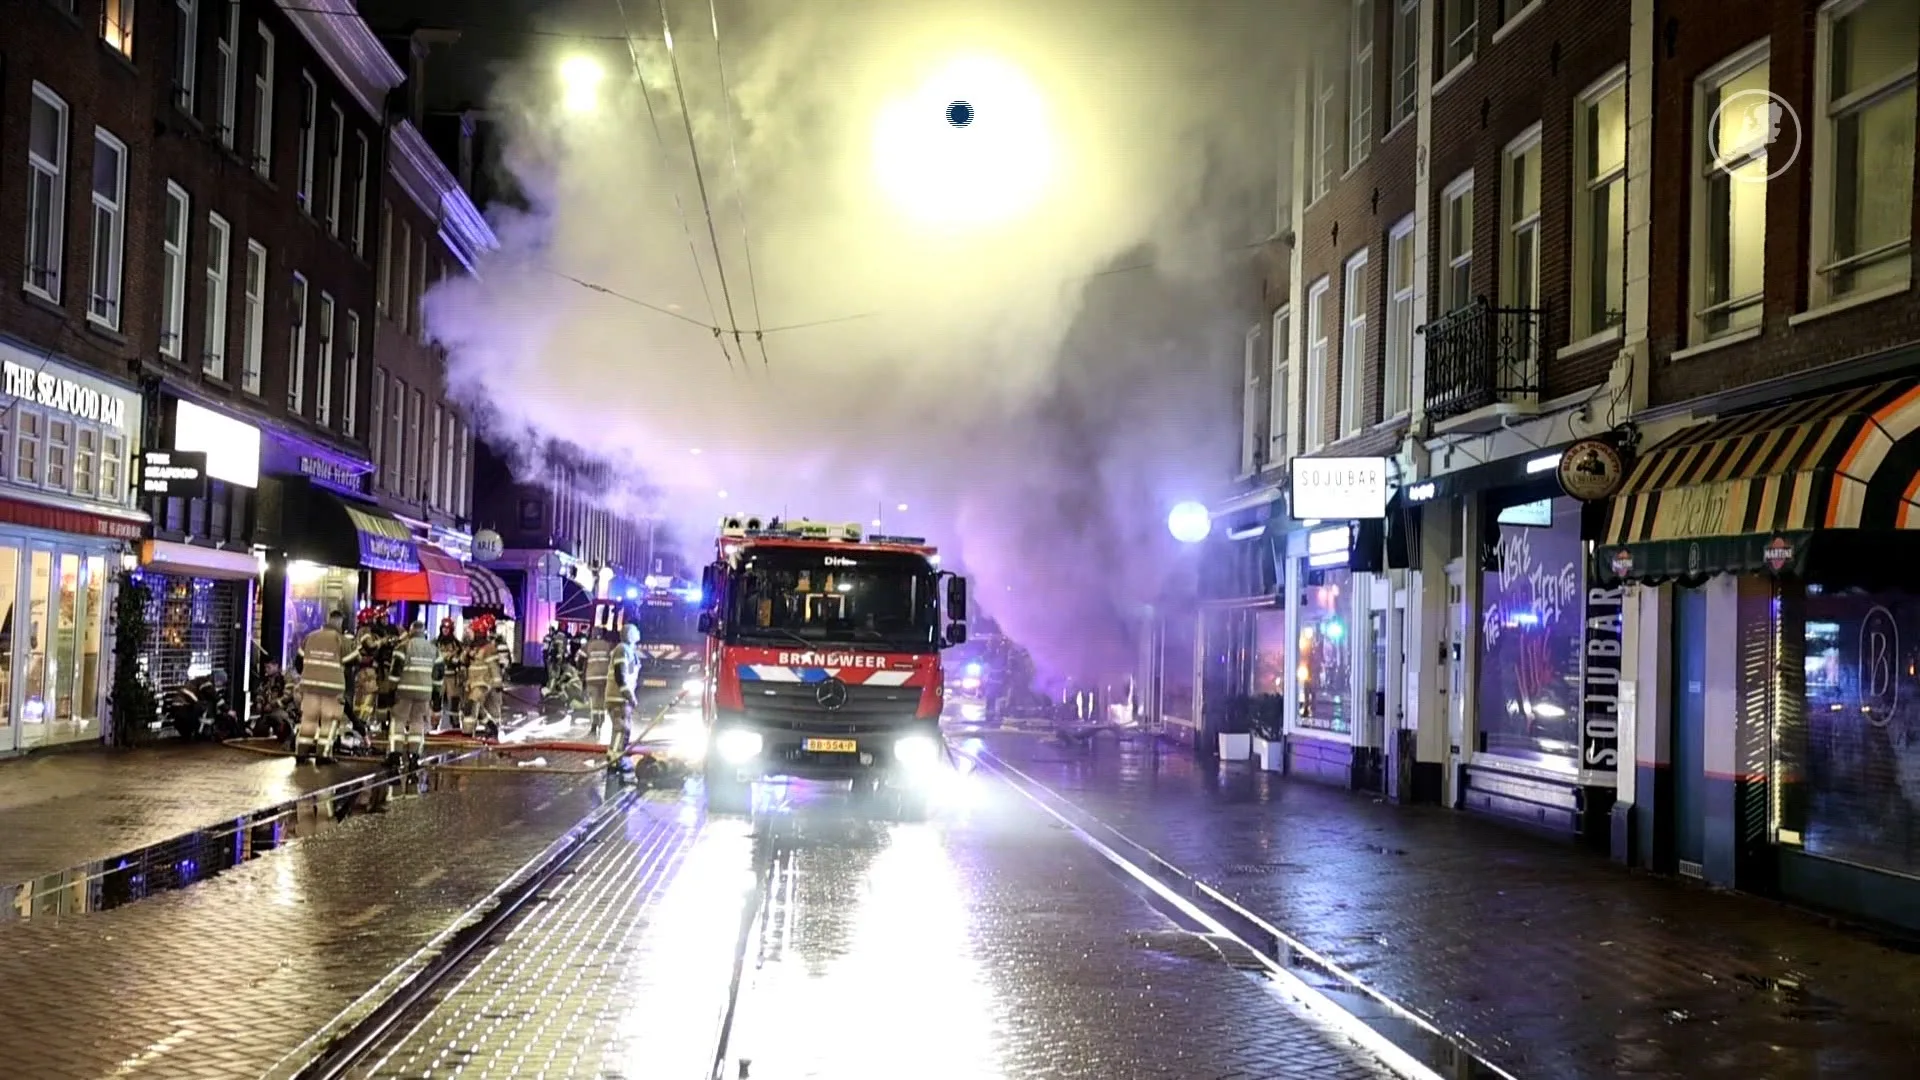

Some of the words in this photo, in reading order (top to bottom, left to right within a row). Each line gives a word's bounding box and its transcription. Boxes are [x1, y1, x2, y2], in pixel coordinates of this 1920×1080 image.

[4, 360, 35, 401] THE
[37, 371, 99, 419] SEAFOOD
[100, 393, 125, 429] BAR
[145, 452, 170, 465] THE
[144, 466, 198, 479] SEAFOOD
[144, 480, 168, 492] BAR
[779, 652, 886, 668] BRANDWEER
